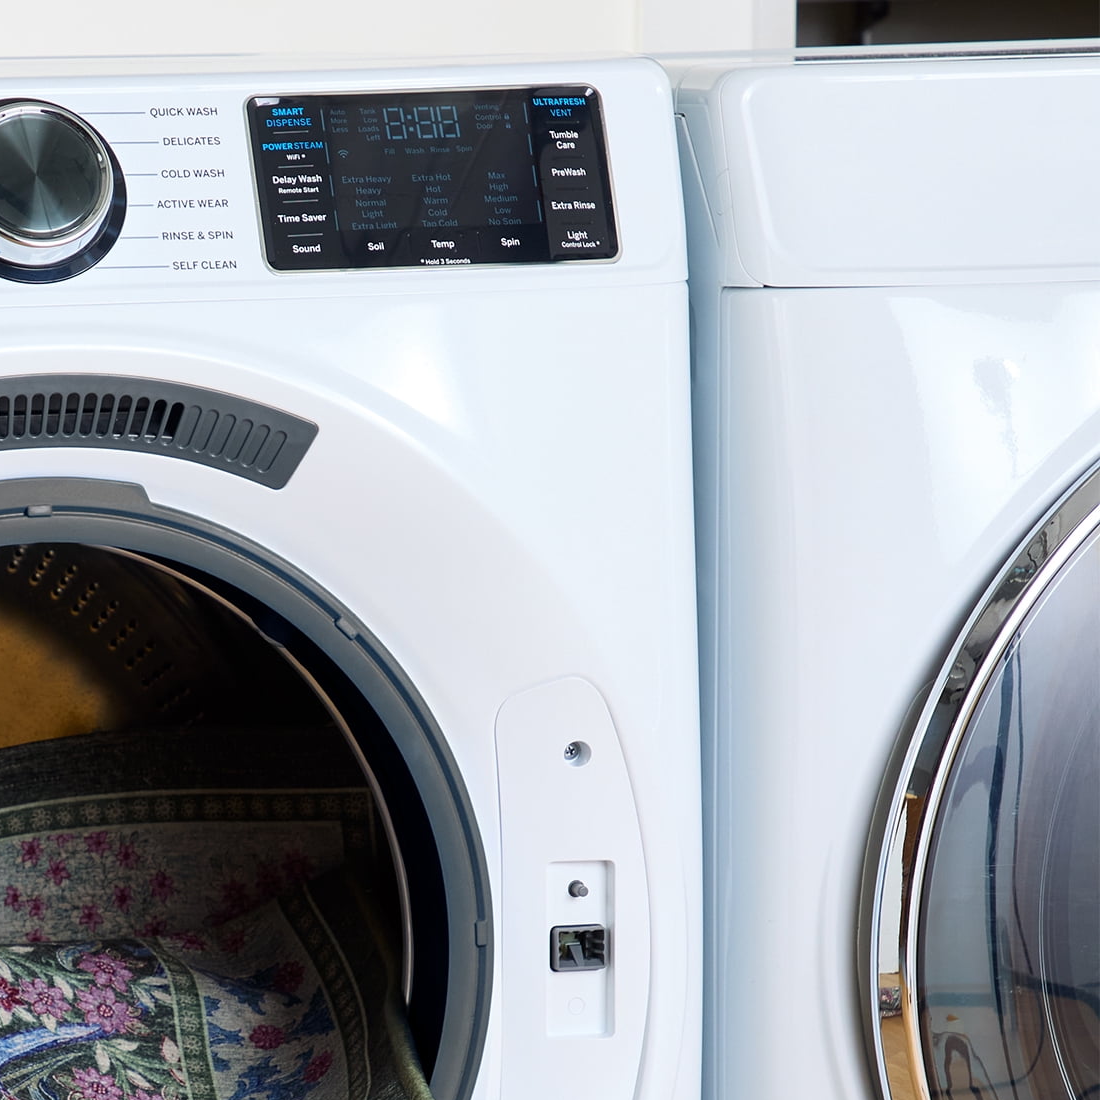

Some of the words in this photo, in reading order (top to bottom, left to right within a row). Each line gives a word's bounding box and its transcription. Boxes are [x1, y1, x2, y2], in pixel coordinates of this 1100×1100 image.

[150, 108, 184, 117] QUICK
[267, 119, 311, 127] DISPENSE
[549, 131, 578, 139] Tumble
[163, 137, 220, 145] DELICATES
[557, 141, 575, 149] Care
[161, 170, 190, 178] COLD
[193, 169, 224, 178] WASH
[552, 168, 586, 176] PreWash
[272, 176, 296, 184] Delay
[366, 175, 391, 184] Heavy
[412, 174, 434, 182] Extra
[356, 187, 381, 195] Heavy
[490, 183, 508, 192] High
[484, 195, 518, 203] Medium
[157, 200, 195, 208] ACTIVE
[197, 199, 228, 208] WEAR
[362, 210, 383, 218] Light
[440, 219, 458, 227] Cold
[162, 232, 194, 240] RINSE
[208, 231, 233, 239] SPIN
[567, 231, 587, 240] Light
[368, 242, 384, 250] Soil
[431, 240, 455, 249] Temp
[501, 238, 520, 247] Spin
[293, 245, 321, 253] Sound
[173, 262, 198, 270] SELF
[201, 261, 237, 269] CLEAN
